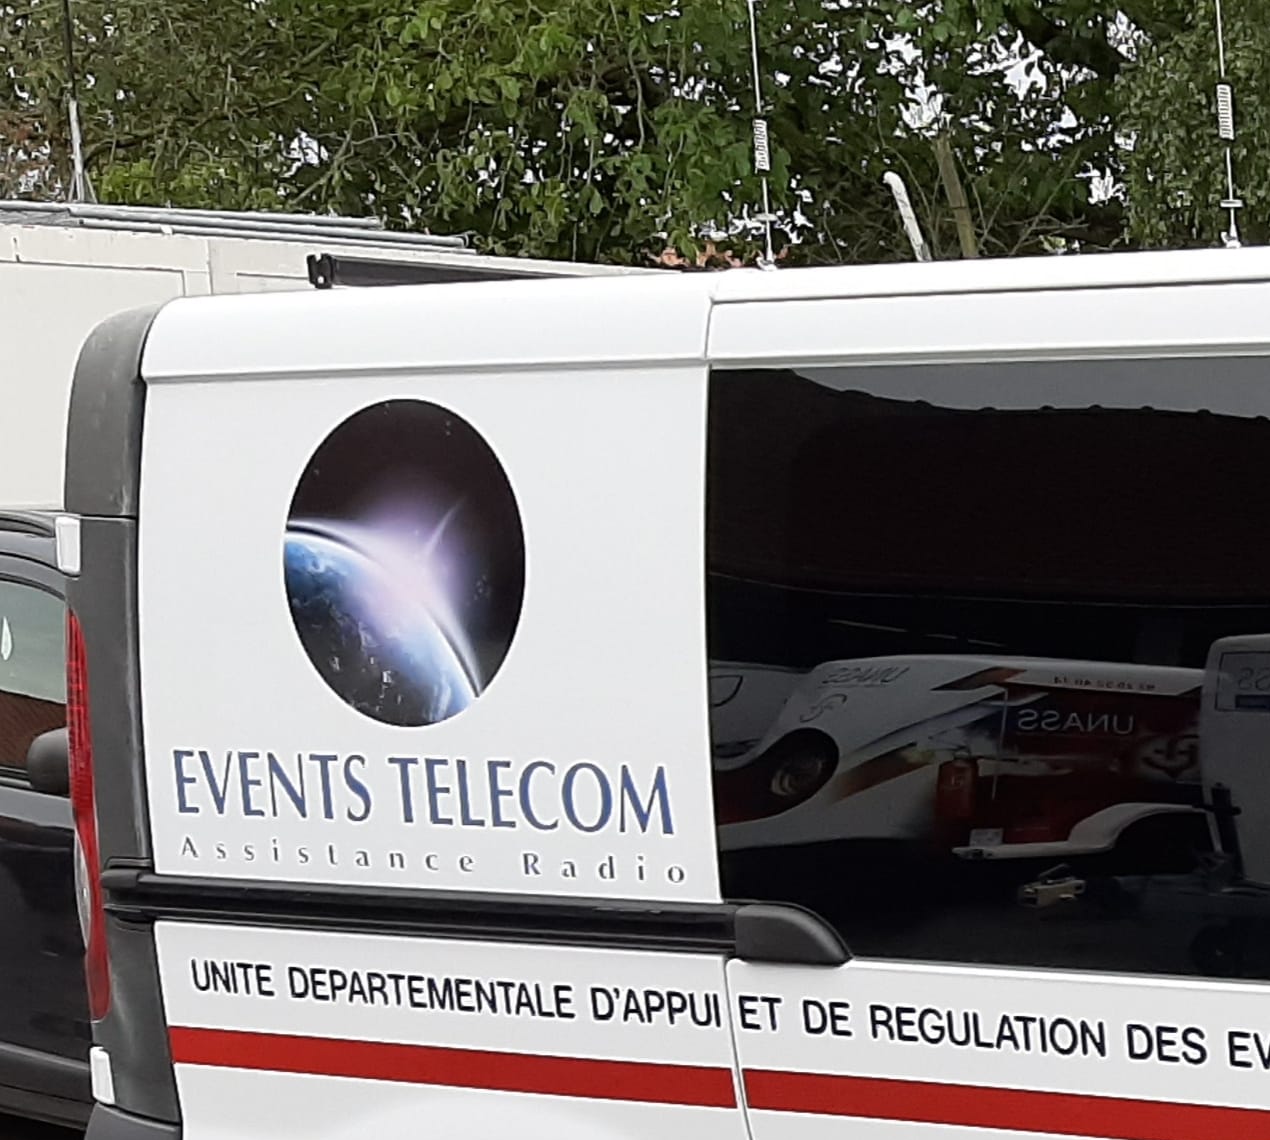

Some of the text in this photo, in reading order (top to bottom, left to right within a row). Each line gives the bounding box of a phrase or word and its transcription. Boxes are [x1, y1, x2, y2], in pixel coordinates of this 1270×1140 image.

[172, 749, 675, 835] EVENTS TELECOM
[180, 835, 686, 884] Assistance Radio
[190, 957, 274, 997] UNITE
[287, 965, 576, 1020] DEPARTEMENTALE
[589, 984, 723, 1028] D'APPUI
[738, 994, 782, 1031] ET
[802, 999, 853, 1037] DE
[869, 1003, 1107, 1057] REGULATION
[1126, 1022, 1208, 1065] DES
